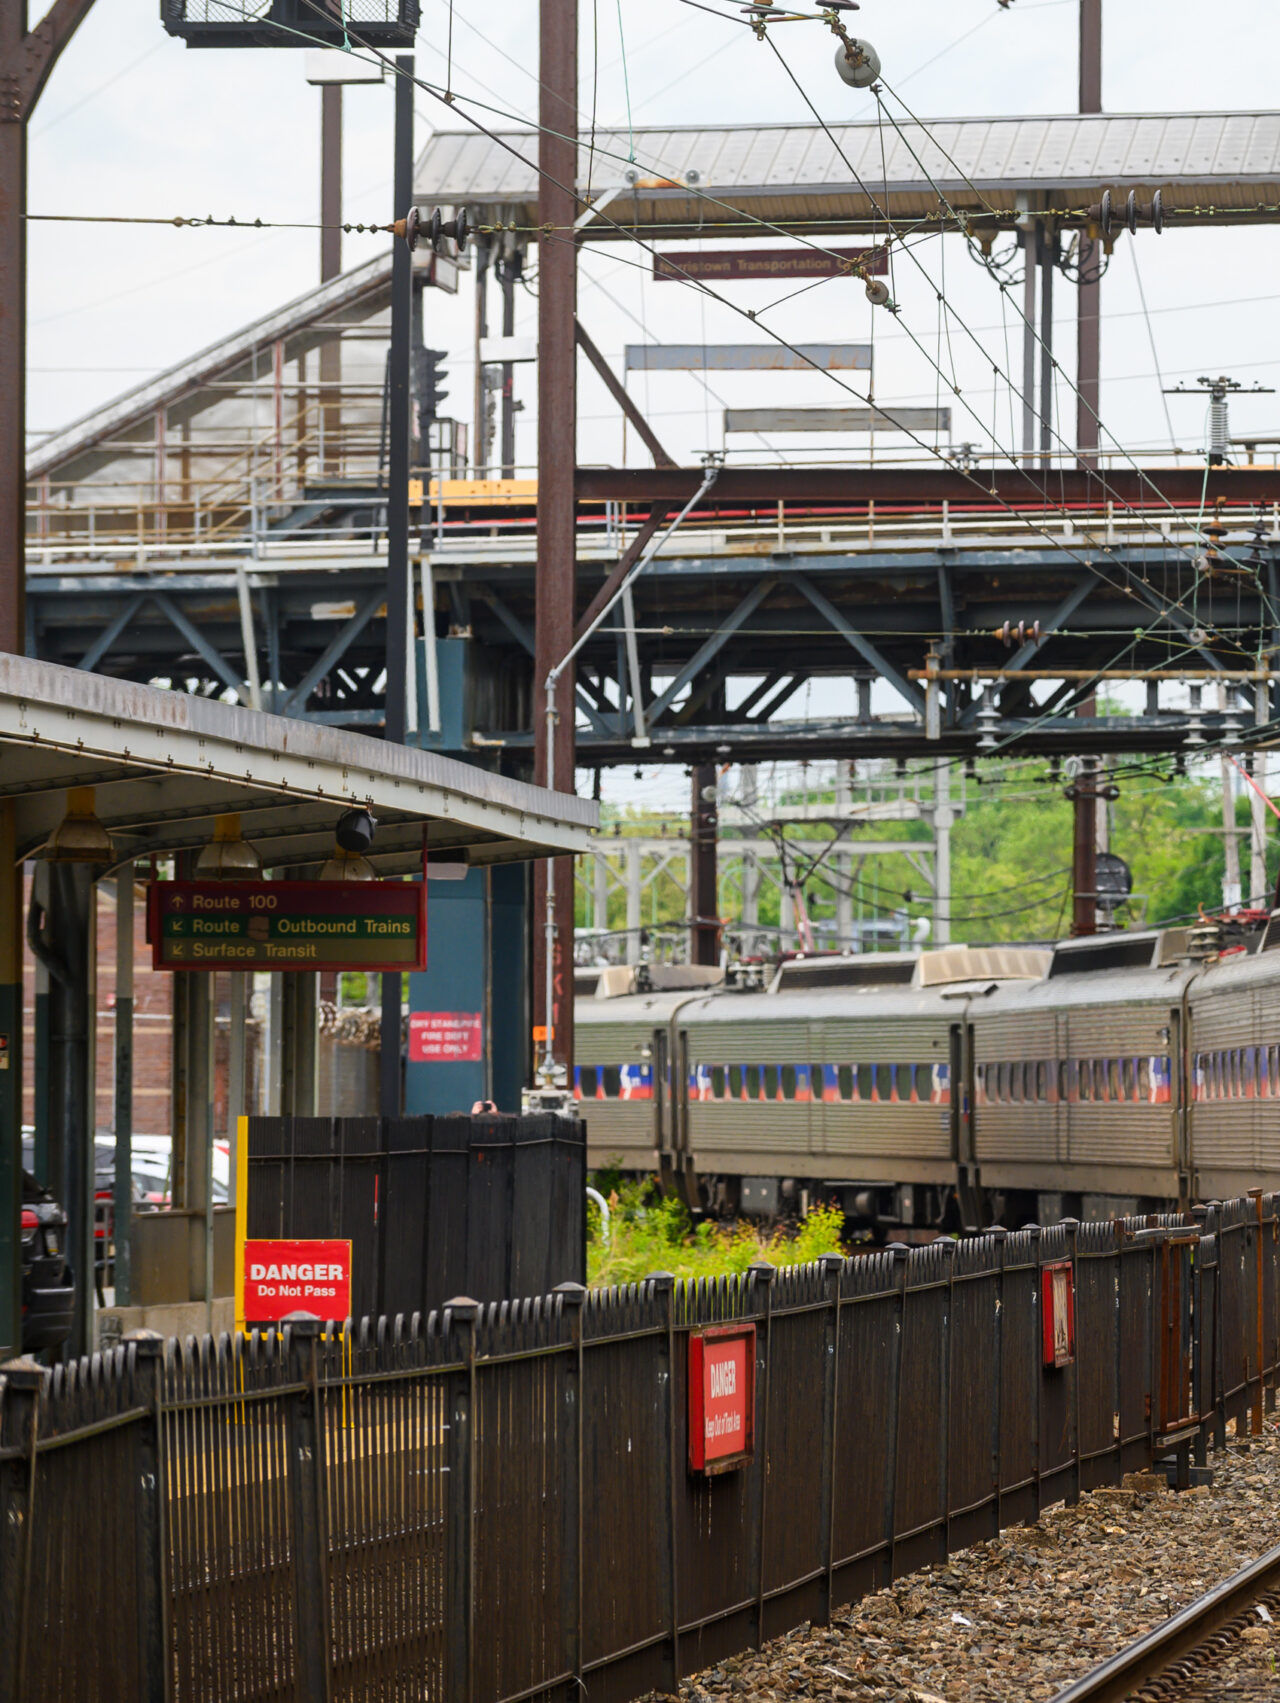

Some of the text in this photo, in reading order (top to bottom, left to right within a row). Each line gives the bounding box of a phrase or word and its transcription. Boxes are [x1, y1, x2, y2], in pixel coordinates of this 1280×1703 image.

[737, 257, 831, 272] Transportation
[192, 895, 277, 909] Route 100
[192, 918, 411, 933] Route Outbound Trains
[192, 943, 317, 957] Surface Transit
[421, 1044, 441, 1054] USE
[250, 1264, 343, 1281] DANGER
[257, 1285, 336, 1297] Do Not Pass
[710, 1360, 736, 1398] DANGER
[705, 1416, 715, 1443] Keep
